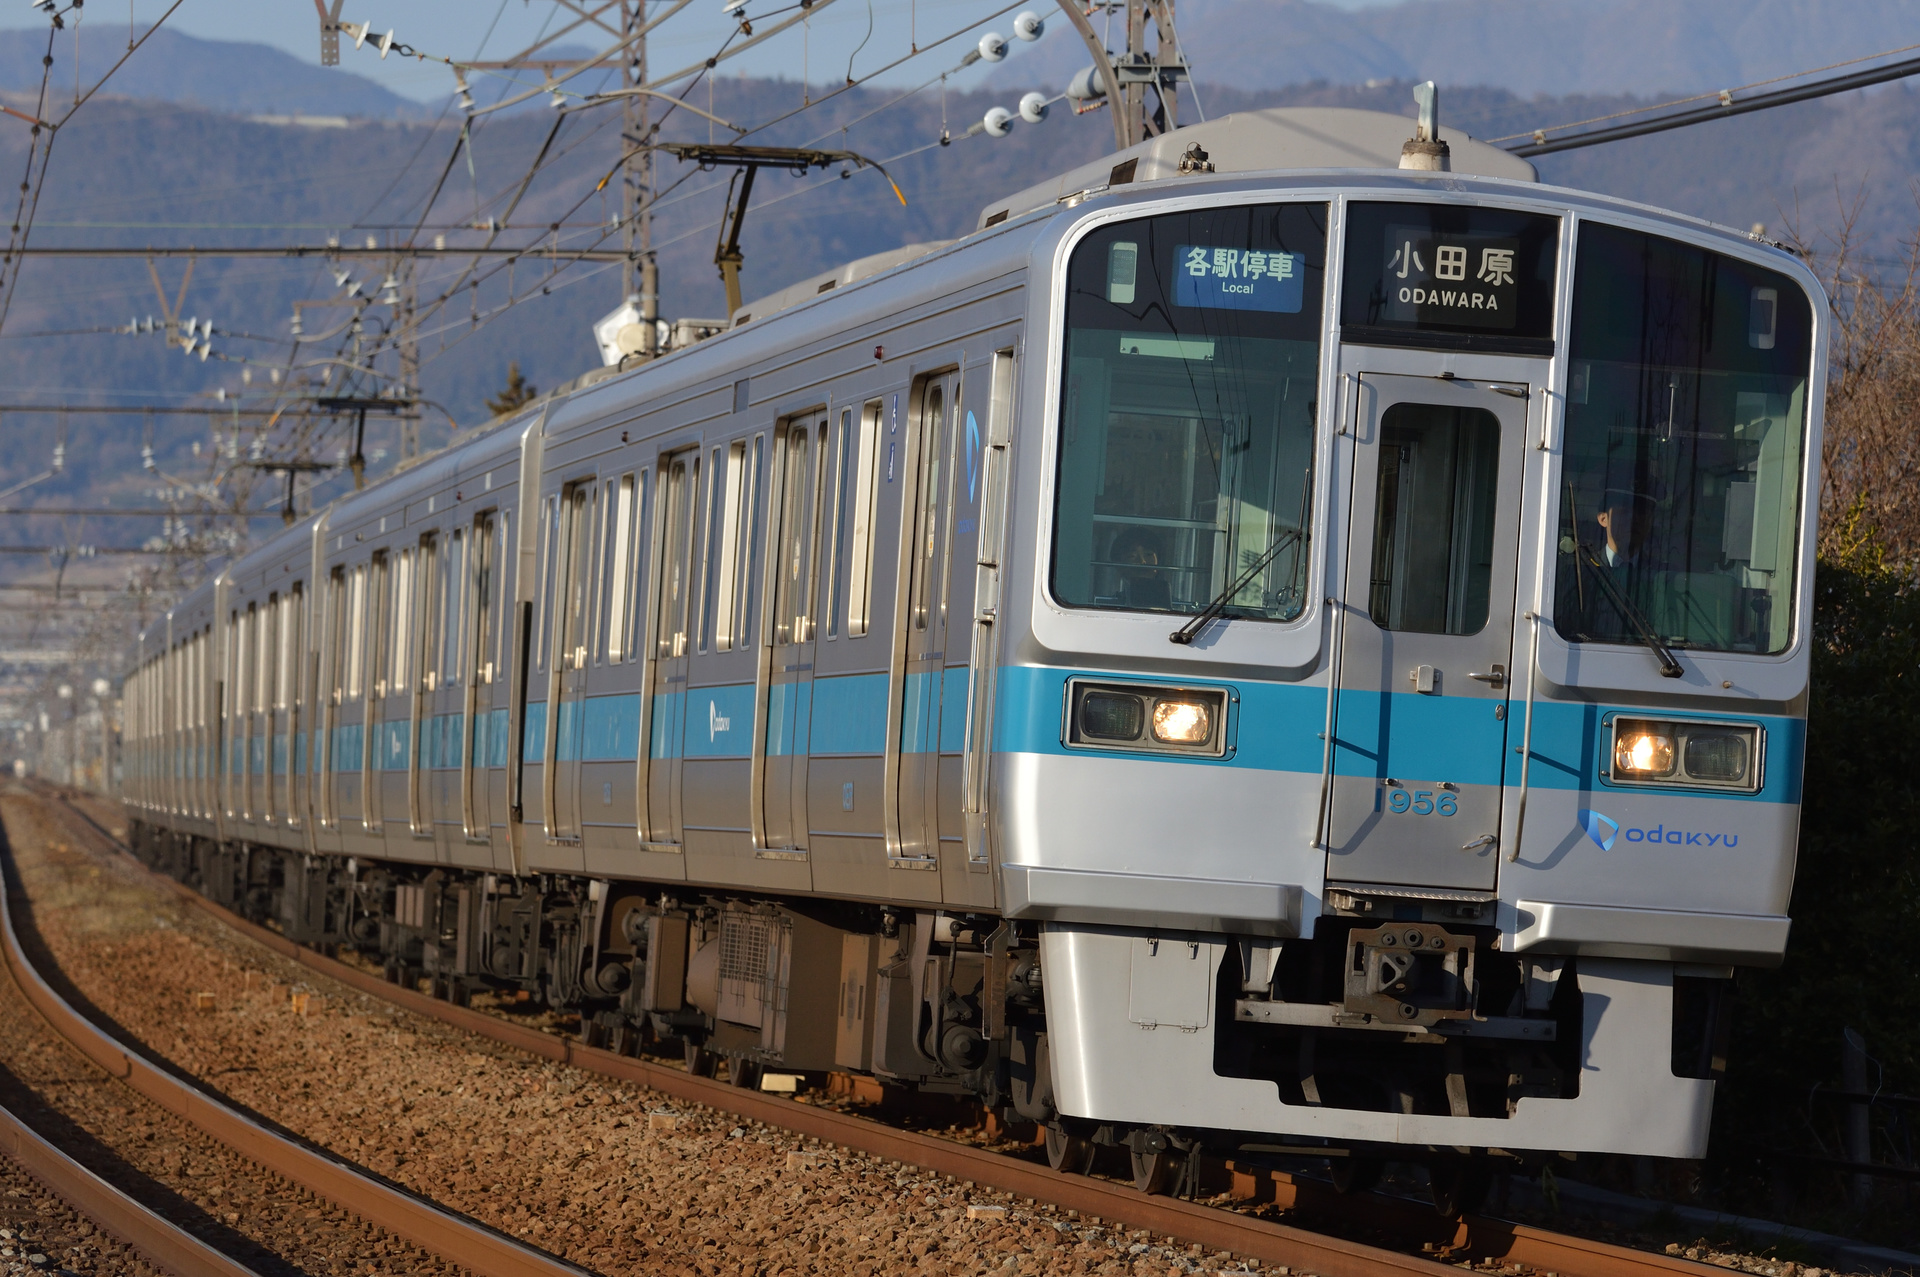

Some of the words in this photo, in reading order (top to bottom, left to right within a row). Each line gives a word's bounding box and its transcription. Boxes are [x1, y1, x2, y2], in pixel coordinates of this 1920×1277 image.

[1184, 246, 1294, 282] 各駅停車
[1387, 240, 1515, 286] 小田原
[1222, 281, 1254, 294] Local
[1398, 287, 1498, 310] ODAWARA
[1625, 824, 1738, 848] odakyu
